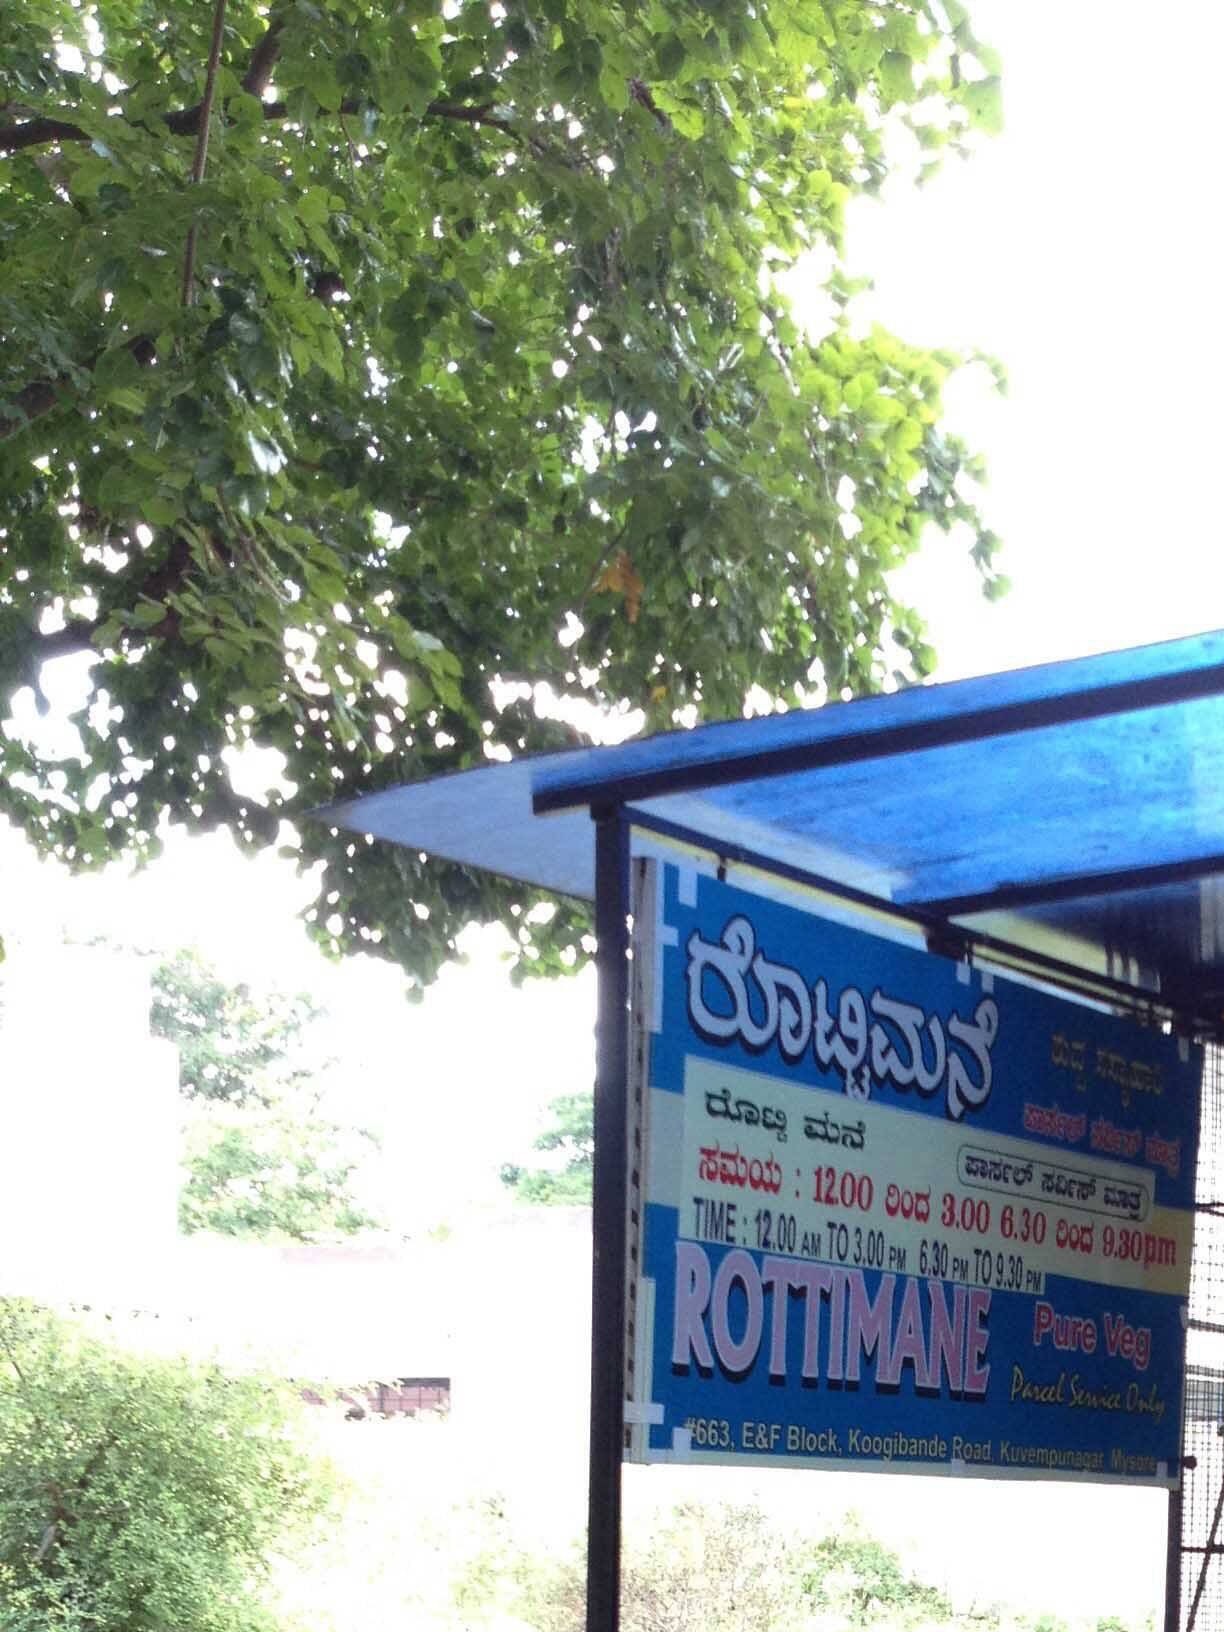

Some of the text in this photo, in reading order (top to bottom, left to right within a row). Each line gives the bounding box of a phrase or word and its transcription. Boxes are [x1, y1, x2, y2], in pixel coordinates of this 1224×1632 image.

[705, 1088, 866, 1150] ರೊಟ್ಟಿ ಮನೆ
[699, 1141, 783, 1195] ಸಮಯ
[813, 1165, 874, 1212] 12.00
[885, 1182, 931, 1224] ರಿಂದ
[942, 1193, 991, 1234] 3.00
[1001, 1205, 1047, 1245] 6.30
[1056, 1218, 1095, 1254] ರಿಂದ
[693, 1197, 737, 1244] TIME
[754, 1208, 797, 1251] 12.00
[801, 1231, 822, 1258] AM
[827, 1221, 849, 1262] TO
[853, 1227, 885, 1268] 3.00
[888, 1246, 907, 1270] PM
[919, 1240, 948, 1277] 6.30
[952, 1258, 969, 1280] PM
[974, 1249, 992, 1285] TO
[996, 1255, 1023, 1290] 9.30
[1026, 1271, 1042, 1293] PM
[671, 1240, 992, 1399] ROTTIMANE
[1033, 1300, 1152, 1371] Pure Veg
[1011, 1364, 1166, 1423] Parcel Service Only
[742, 1421, 781, 1449] E&F
[788, 1424, 842, 1456] Block,
[849, 1429, 947, 1461] Koogibande
